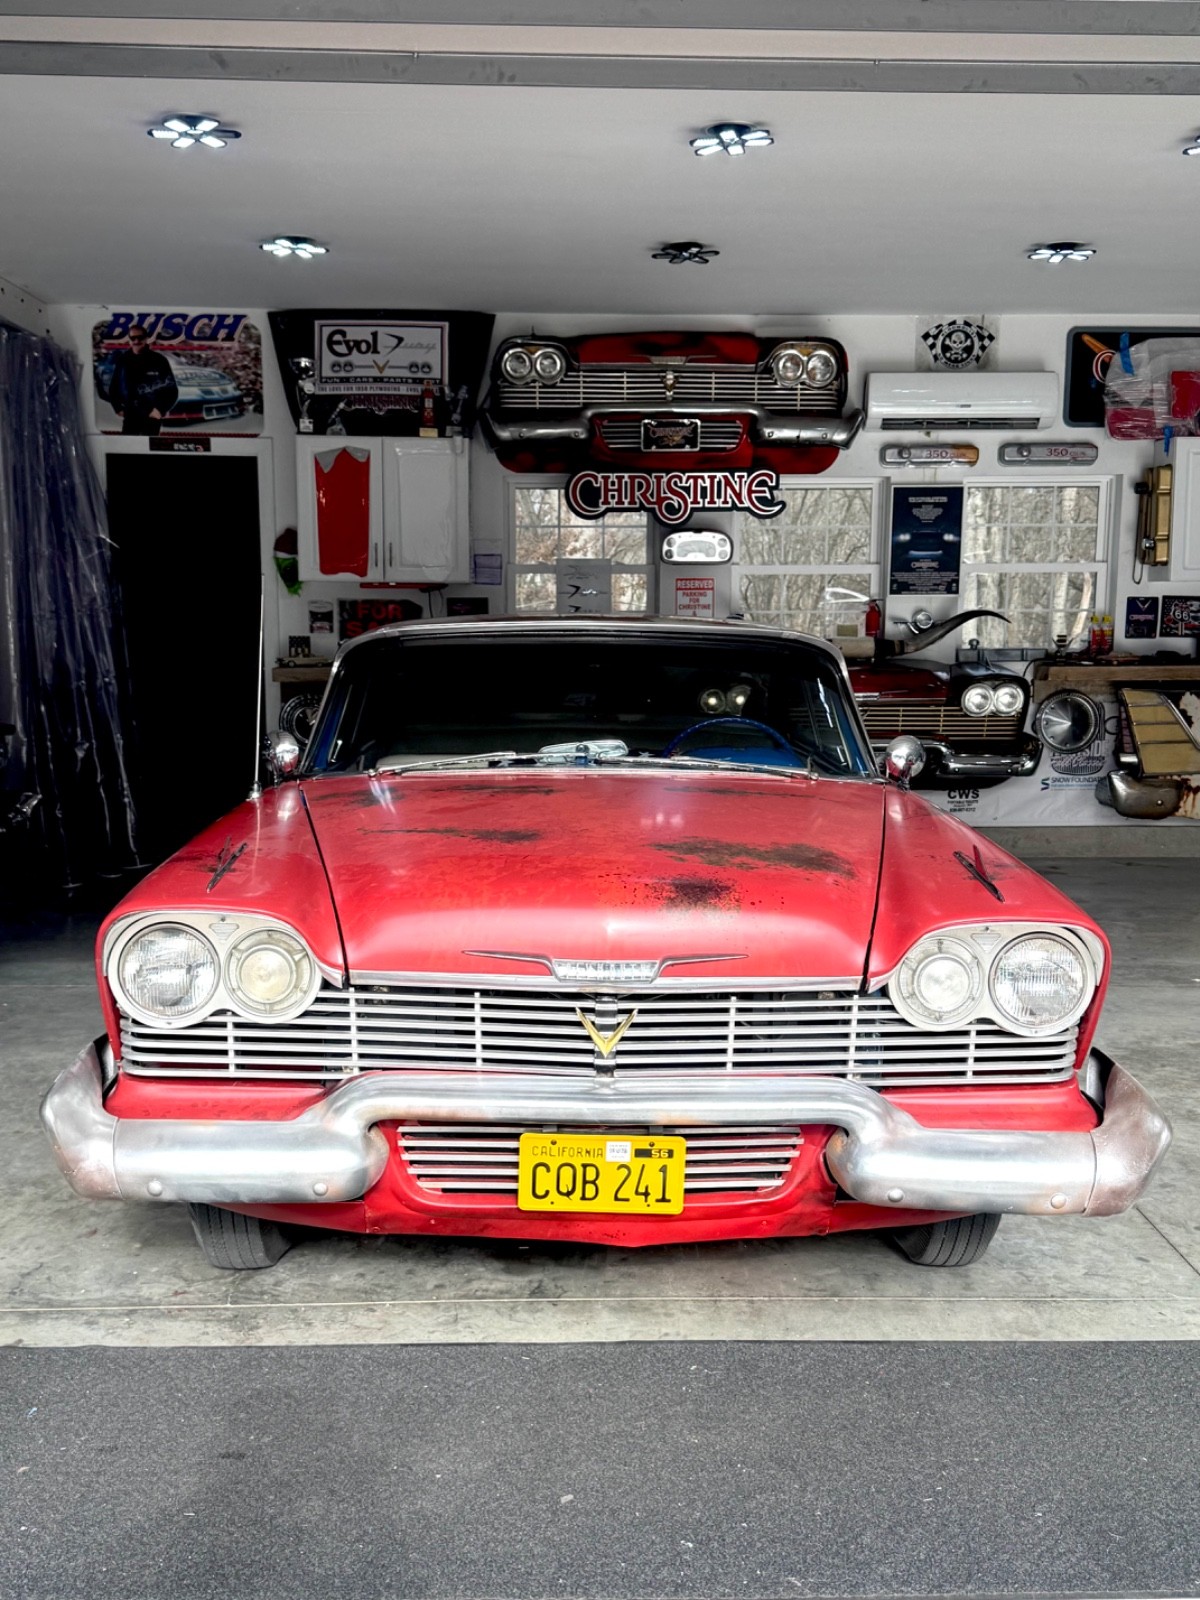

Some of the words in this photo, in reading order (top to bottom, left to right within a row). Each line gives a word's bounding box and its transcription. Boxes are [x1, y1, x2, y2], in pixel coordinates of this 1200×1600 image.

[100, 312, 249, 342] BUSCH
[326, 328, 381, 357] Evol
[925, 448, 948, 458] 350
[1046, 447, 1069, 457] 350
[570, 470, 784, 525] CHRISTINE
[677, 580, 714, 589] RESERVED
[357, 599, 402, 620] FOR
[1174, 609, 1190, 621] 66
[1051, 776, 1070, 784] SNOW
[947, 788, 980, 800] CWS
[532, 1146, 604, 1158] CALIFORNIA
[651, 1149, 669, 1158] 56
[532, 1162, 600, 1201] CQB
[613, 1163, 672, 1203] 241
